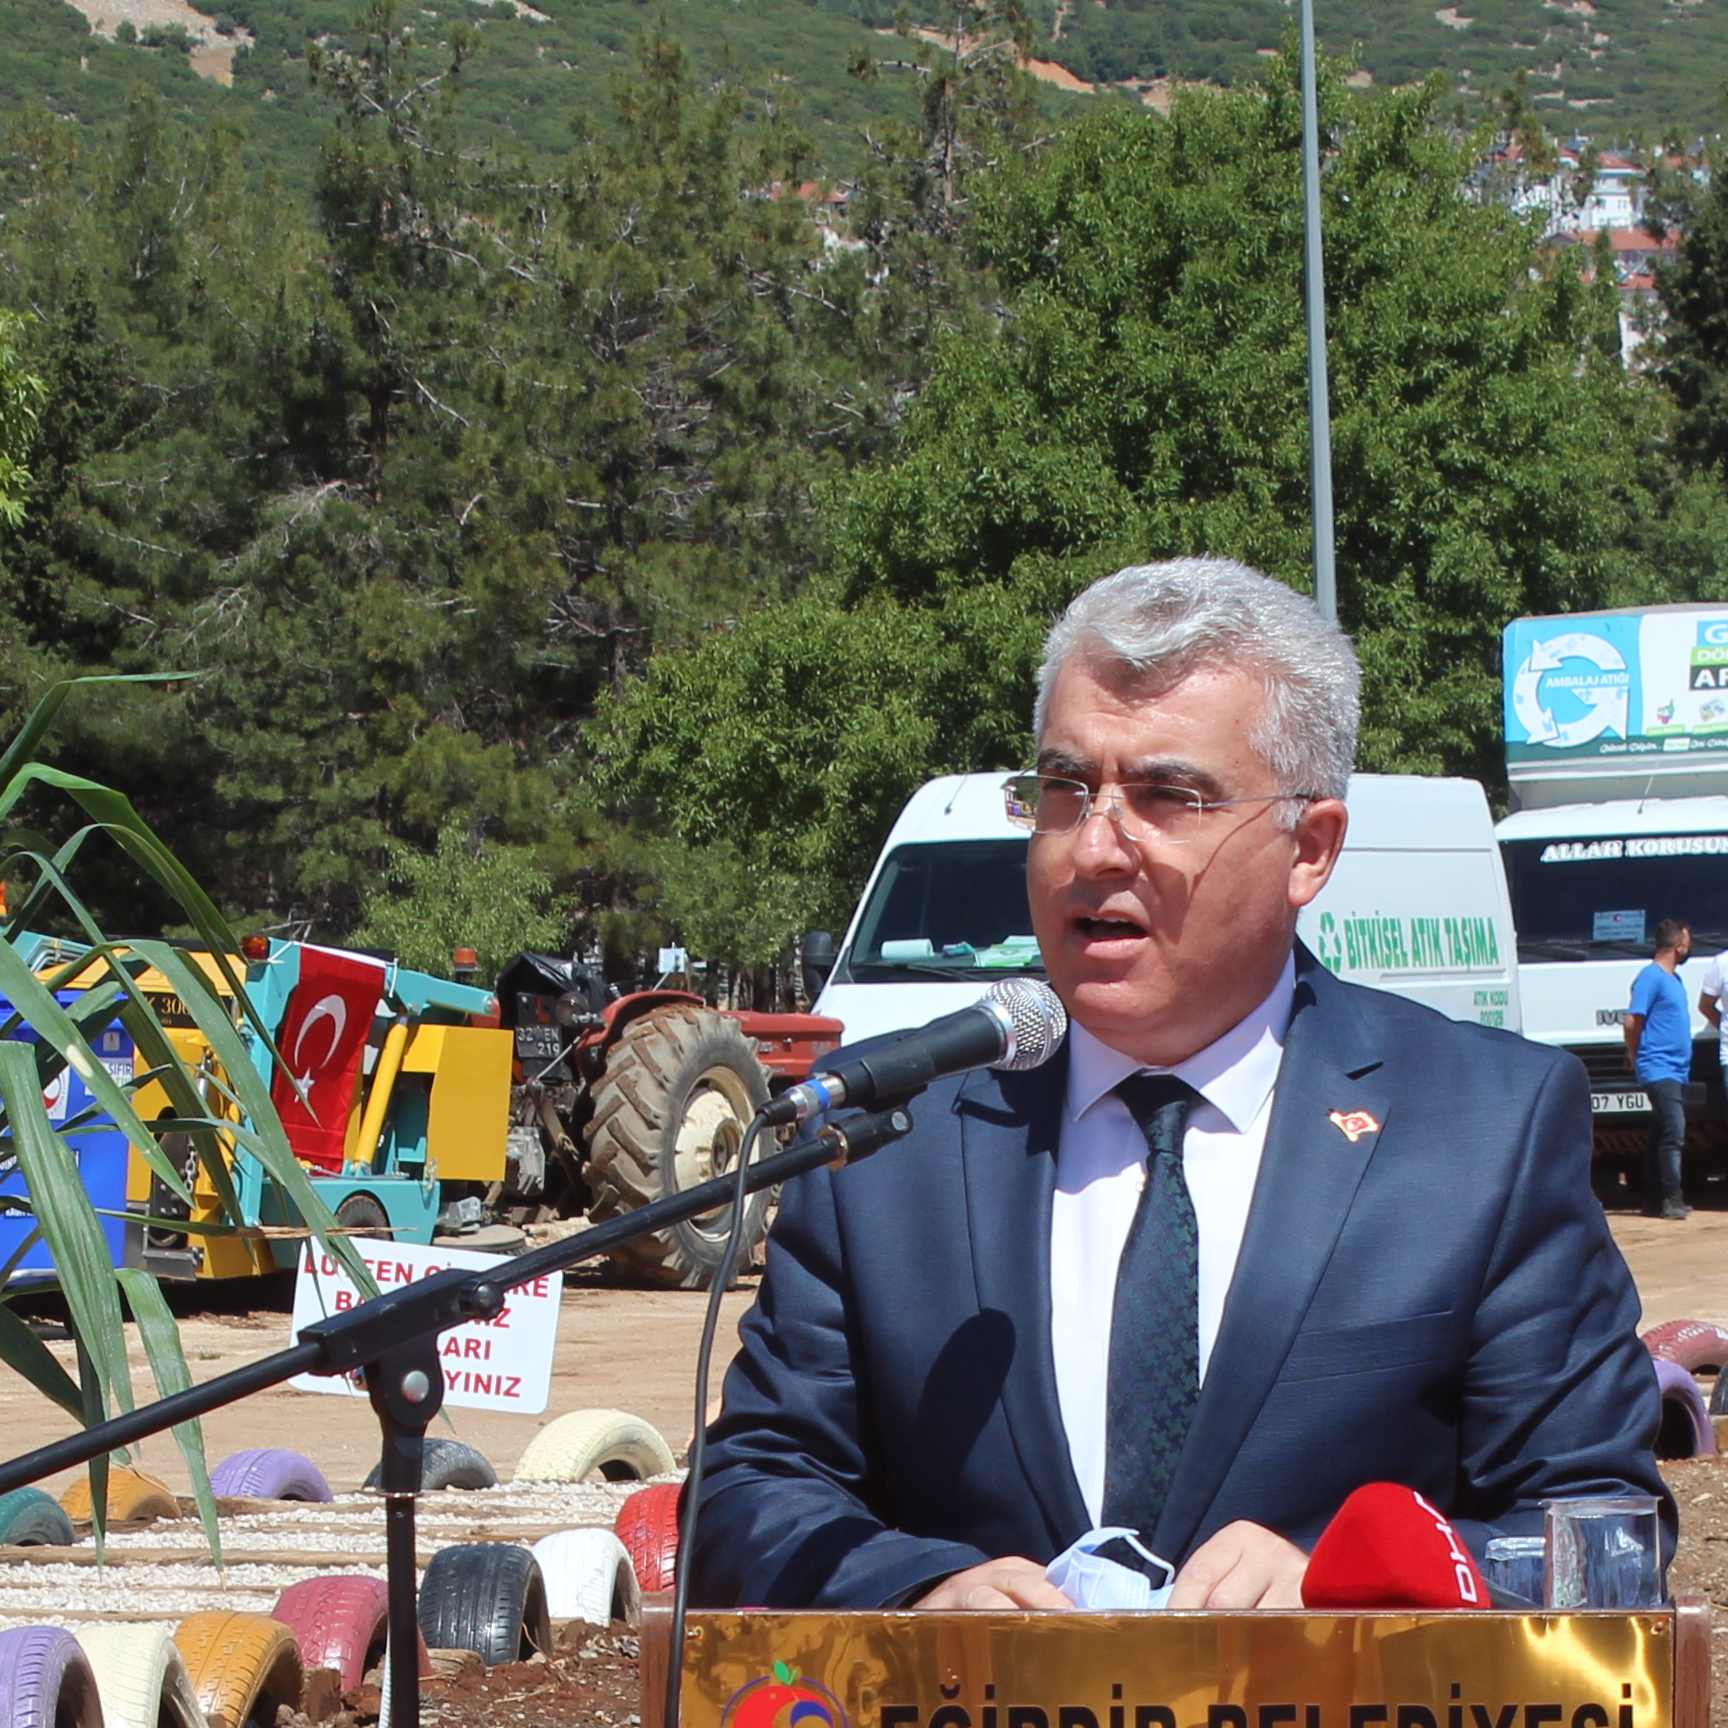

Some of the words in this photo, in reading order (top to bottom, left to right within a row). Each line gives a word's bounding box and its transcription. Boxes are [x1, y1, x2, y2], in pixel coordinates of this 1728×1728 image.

[1545, 675, 1599, 687] AMBALAJ
[1600, 673, 1629, 685] ATIĞI
[1540, 840, 1623, 863] ALLAH
[1343, 910, 1409, 970] BİTKİSEL
[1410, 917, 1445, 968] ATIK
[1443, 917, 1500, 972] TAŞIMA
[1596, 1010, 1626, 1026] IVE
[518, 1027, 533, 1041] 32
[537, 1042, 560, 1056] 219
[108, 1064, 132, 1076] SIFIR
[1617, 1095, 1644, 1109] YGU
